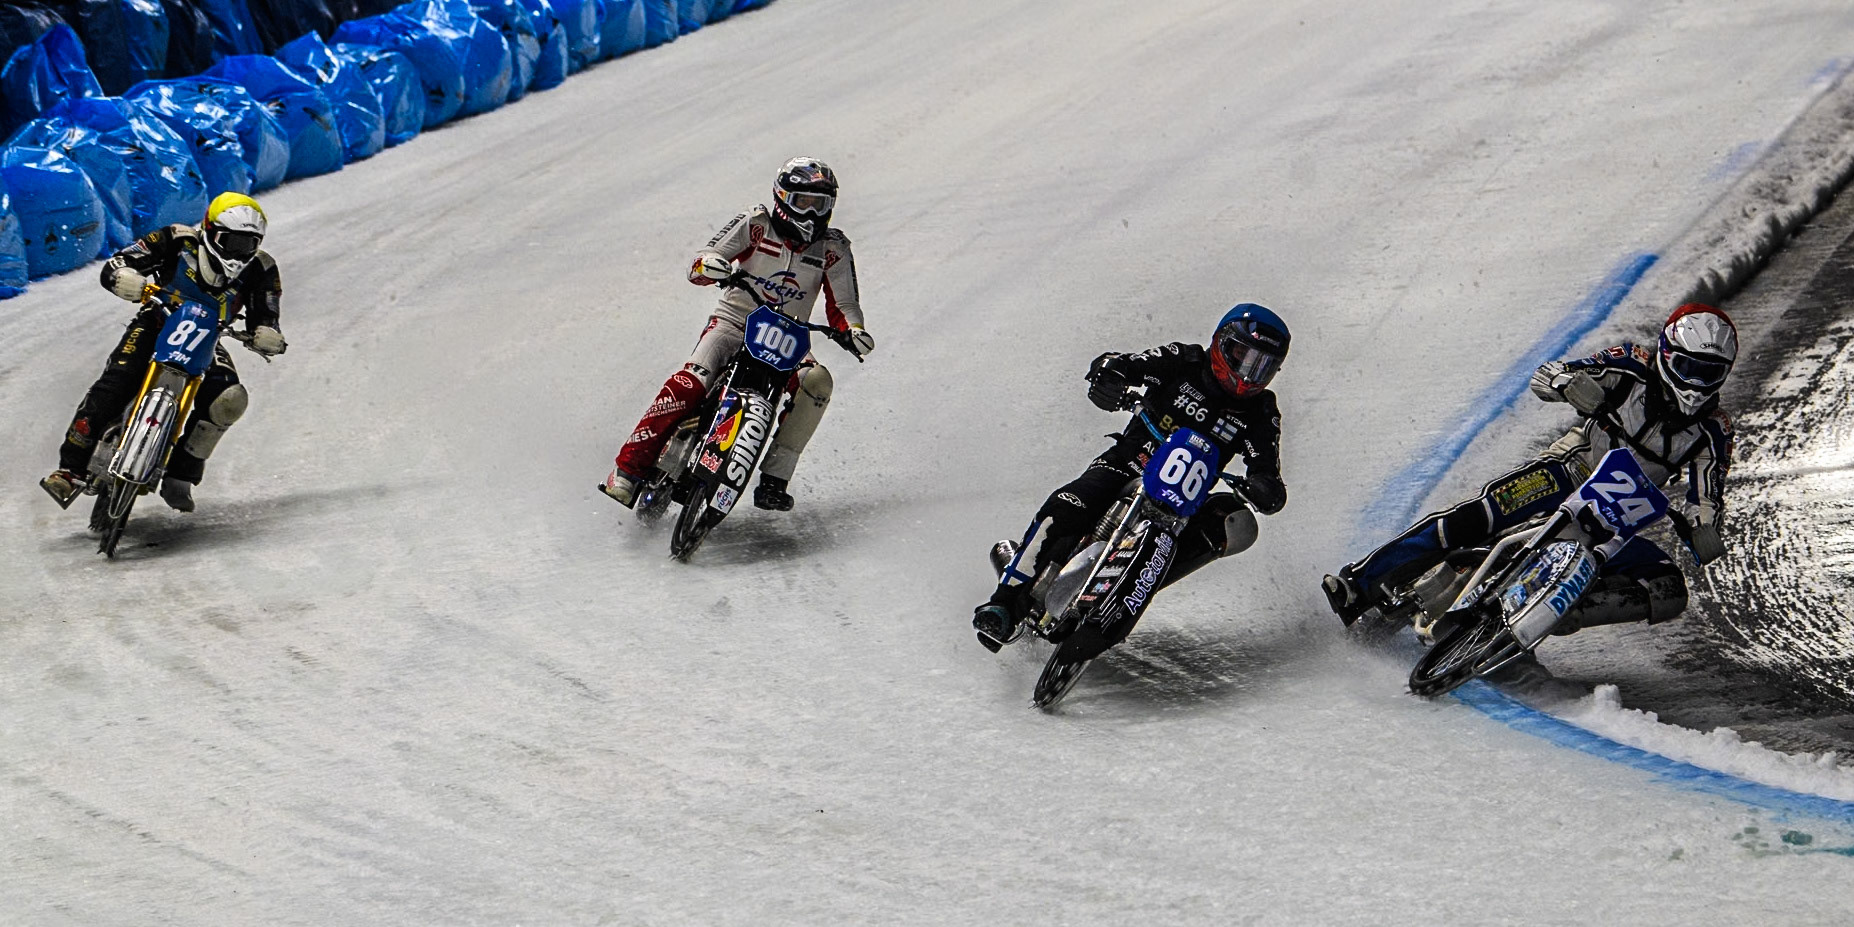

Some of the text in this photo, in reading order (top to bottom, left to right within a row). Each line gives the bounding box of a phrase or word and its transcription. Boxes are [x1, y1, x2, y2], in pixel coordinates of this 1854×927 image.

[755, 276, 807, 301] FUCHS
[167, 320, 210, 352] 81
[754, 322, 797, 359] 100
[169, 350, 191, 364] FIM
[759, 349, 781, 365] FIM
[1173, 394, 1208, 422] #66
[1159, 447, 1208, 500] 66
[1161, 488, 1185, 507] FIM
[1589, 470, 1656, 527] 24
